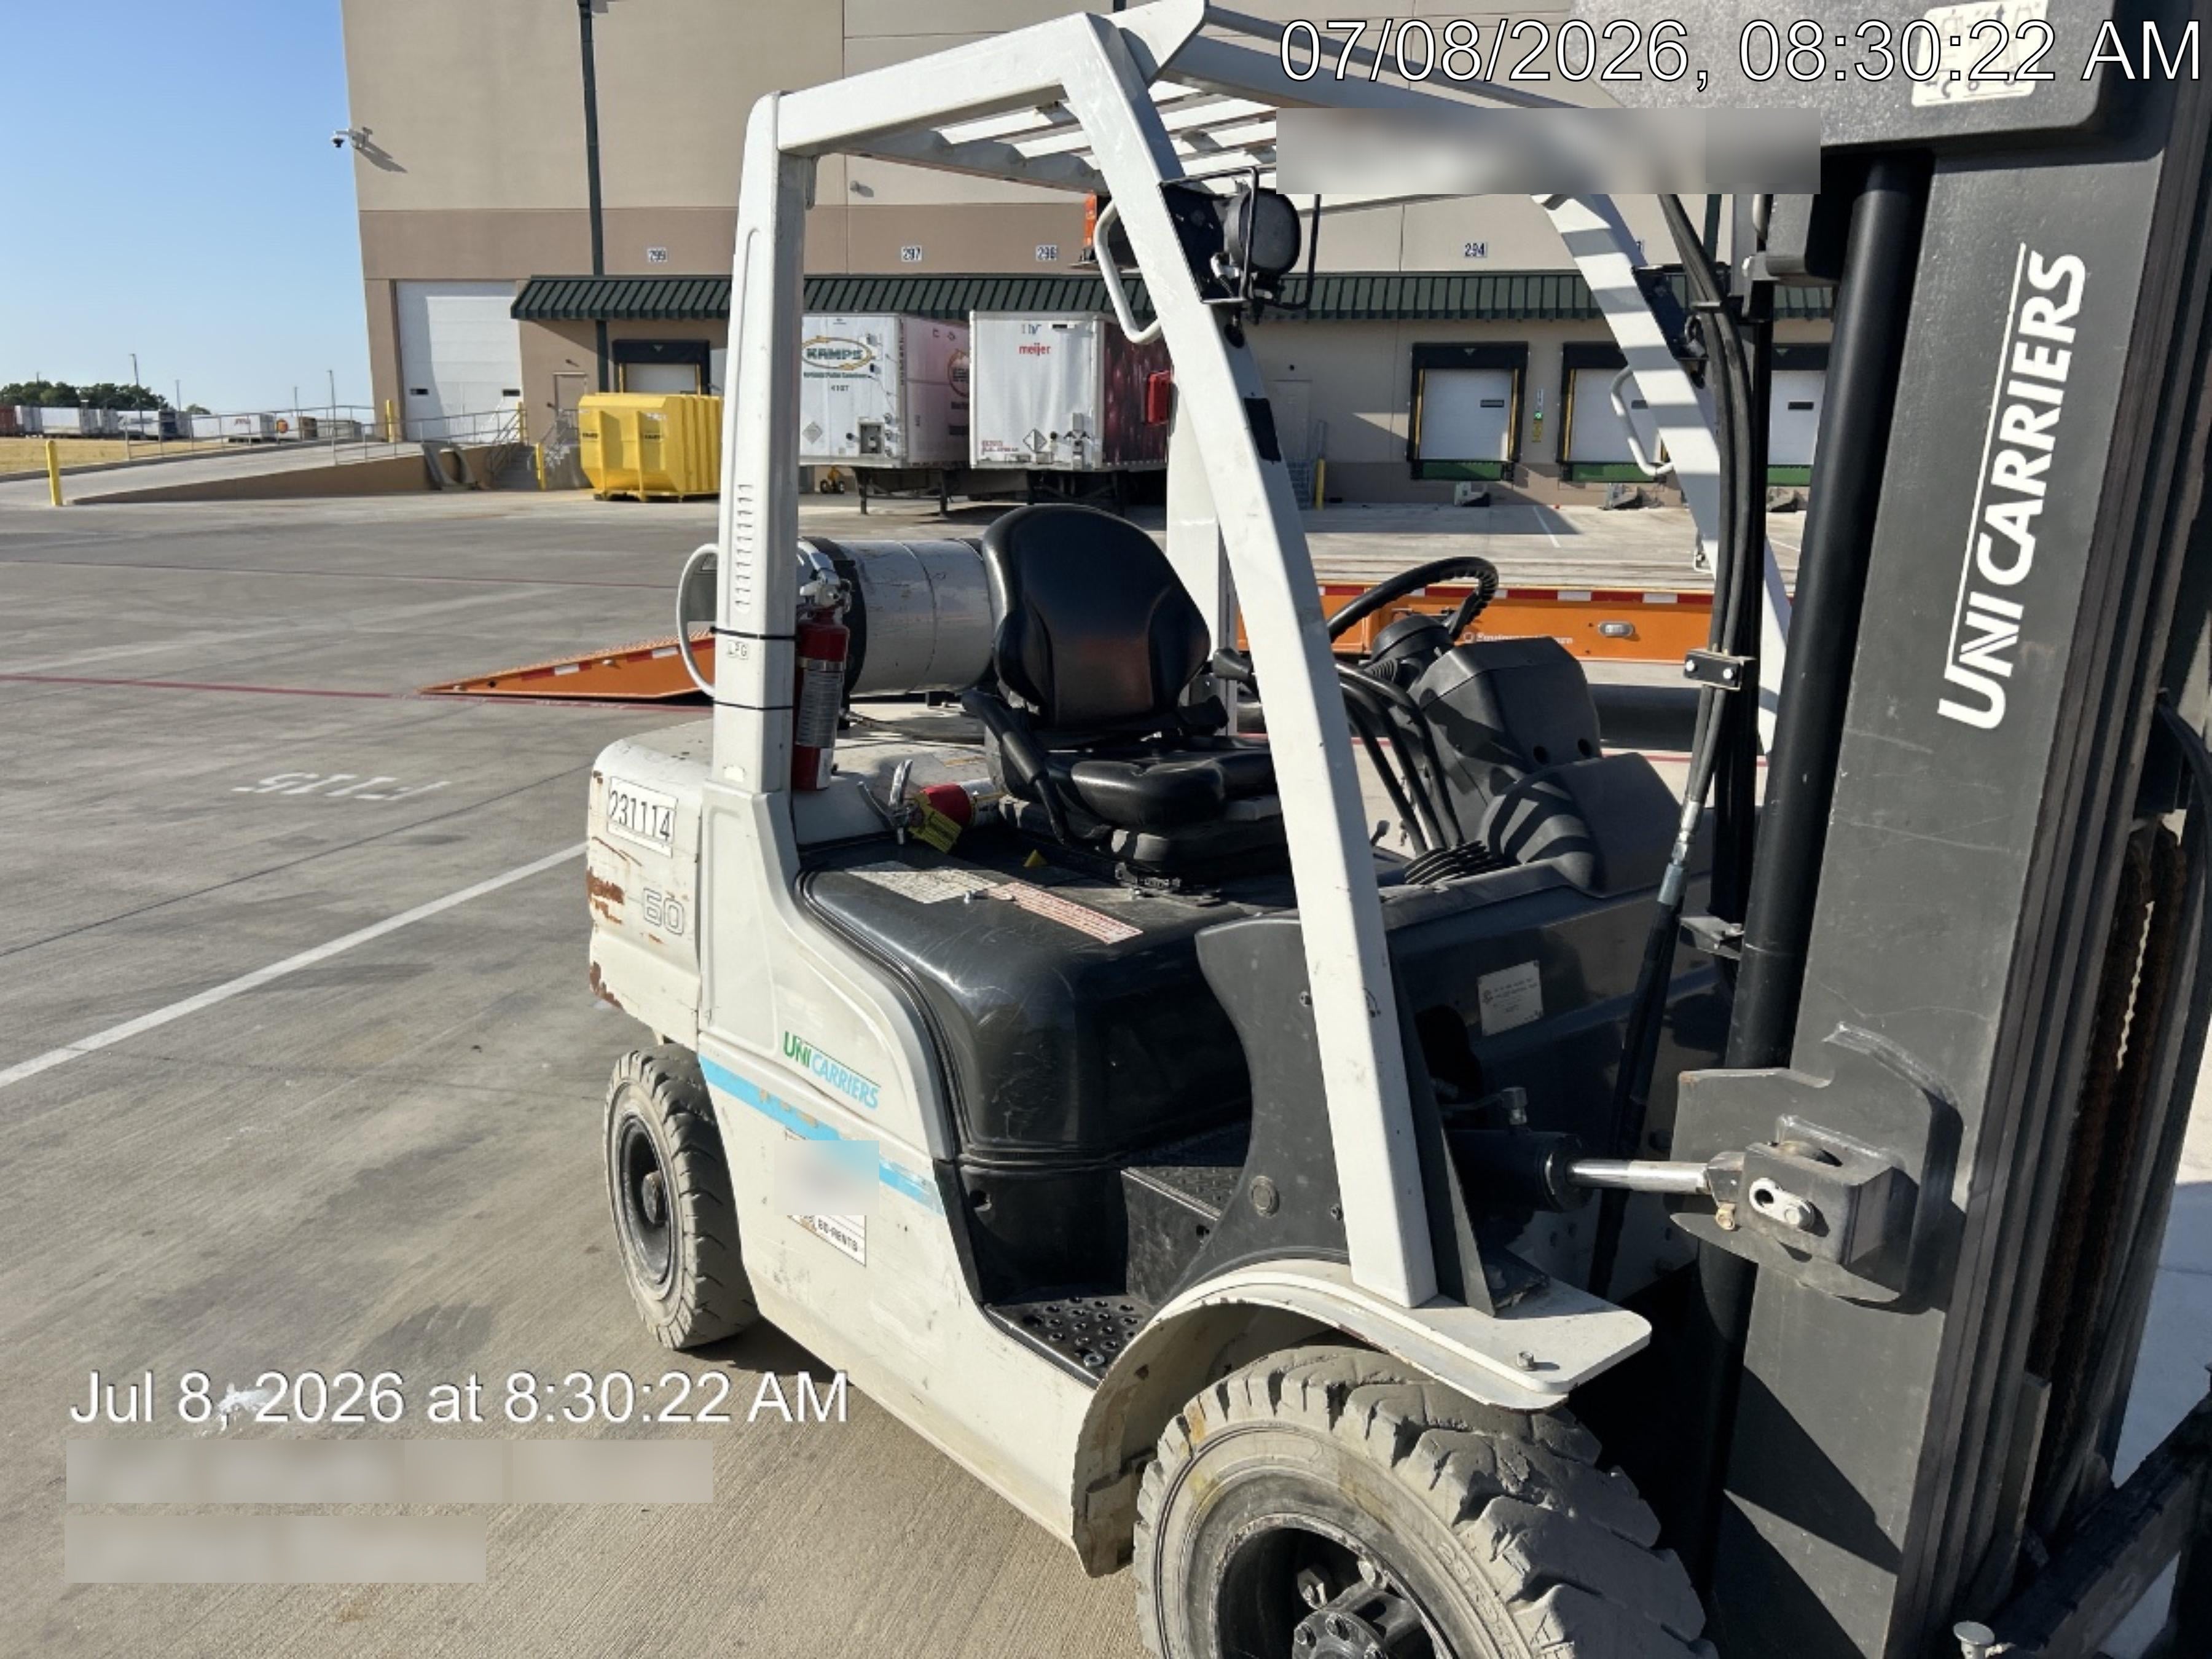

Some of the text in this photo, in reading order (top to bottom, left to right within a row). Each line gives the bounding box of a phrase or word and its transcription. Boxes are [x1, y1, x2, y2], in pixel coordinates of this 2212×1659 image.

[806, 347, 863, 360] KAMPS
[1018, 342, 1051, 356] meijer
[609, 790, 672, 842] 231114
